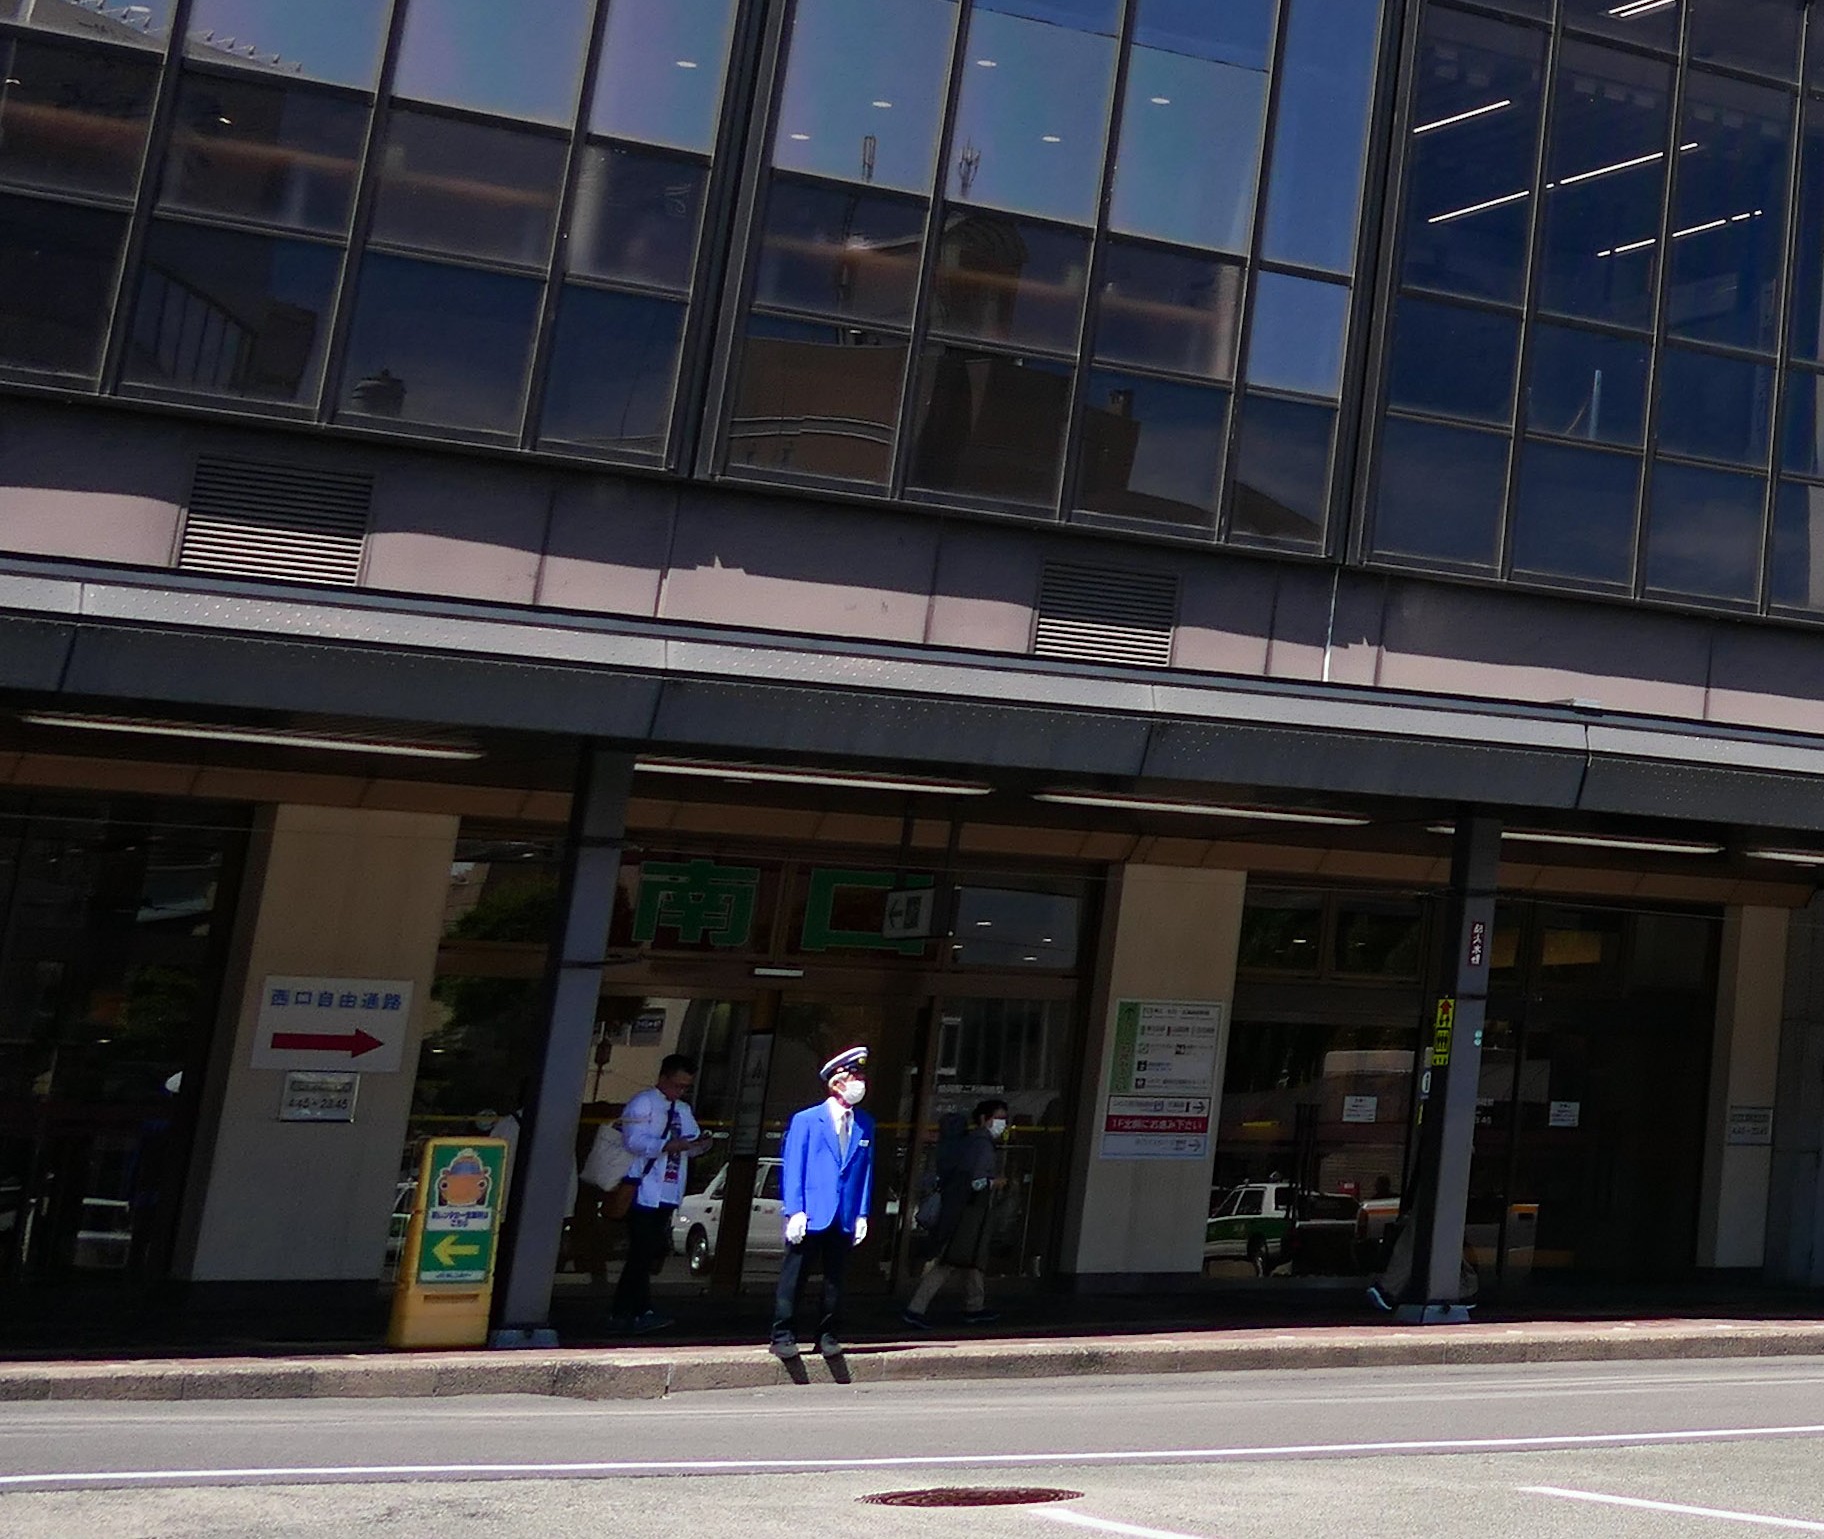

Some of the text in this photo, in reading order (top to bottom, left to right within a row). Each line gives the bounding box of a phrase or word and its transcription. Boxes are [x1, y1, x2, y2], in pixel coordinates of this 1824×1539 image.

[634, 859, 937, 956] 南口
[270, 989, 402, 1011] 西口自由通路
